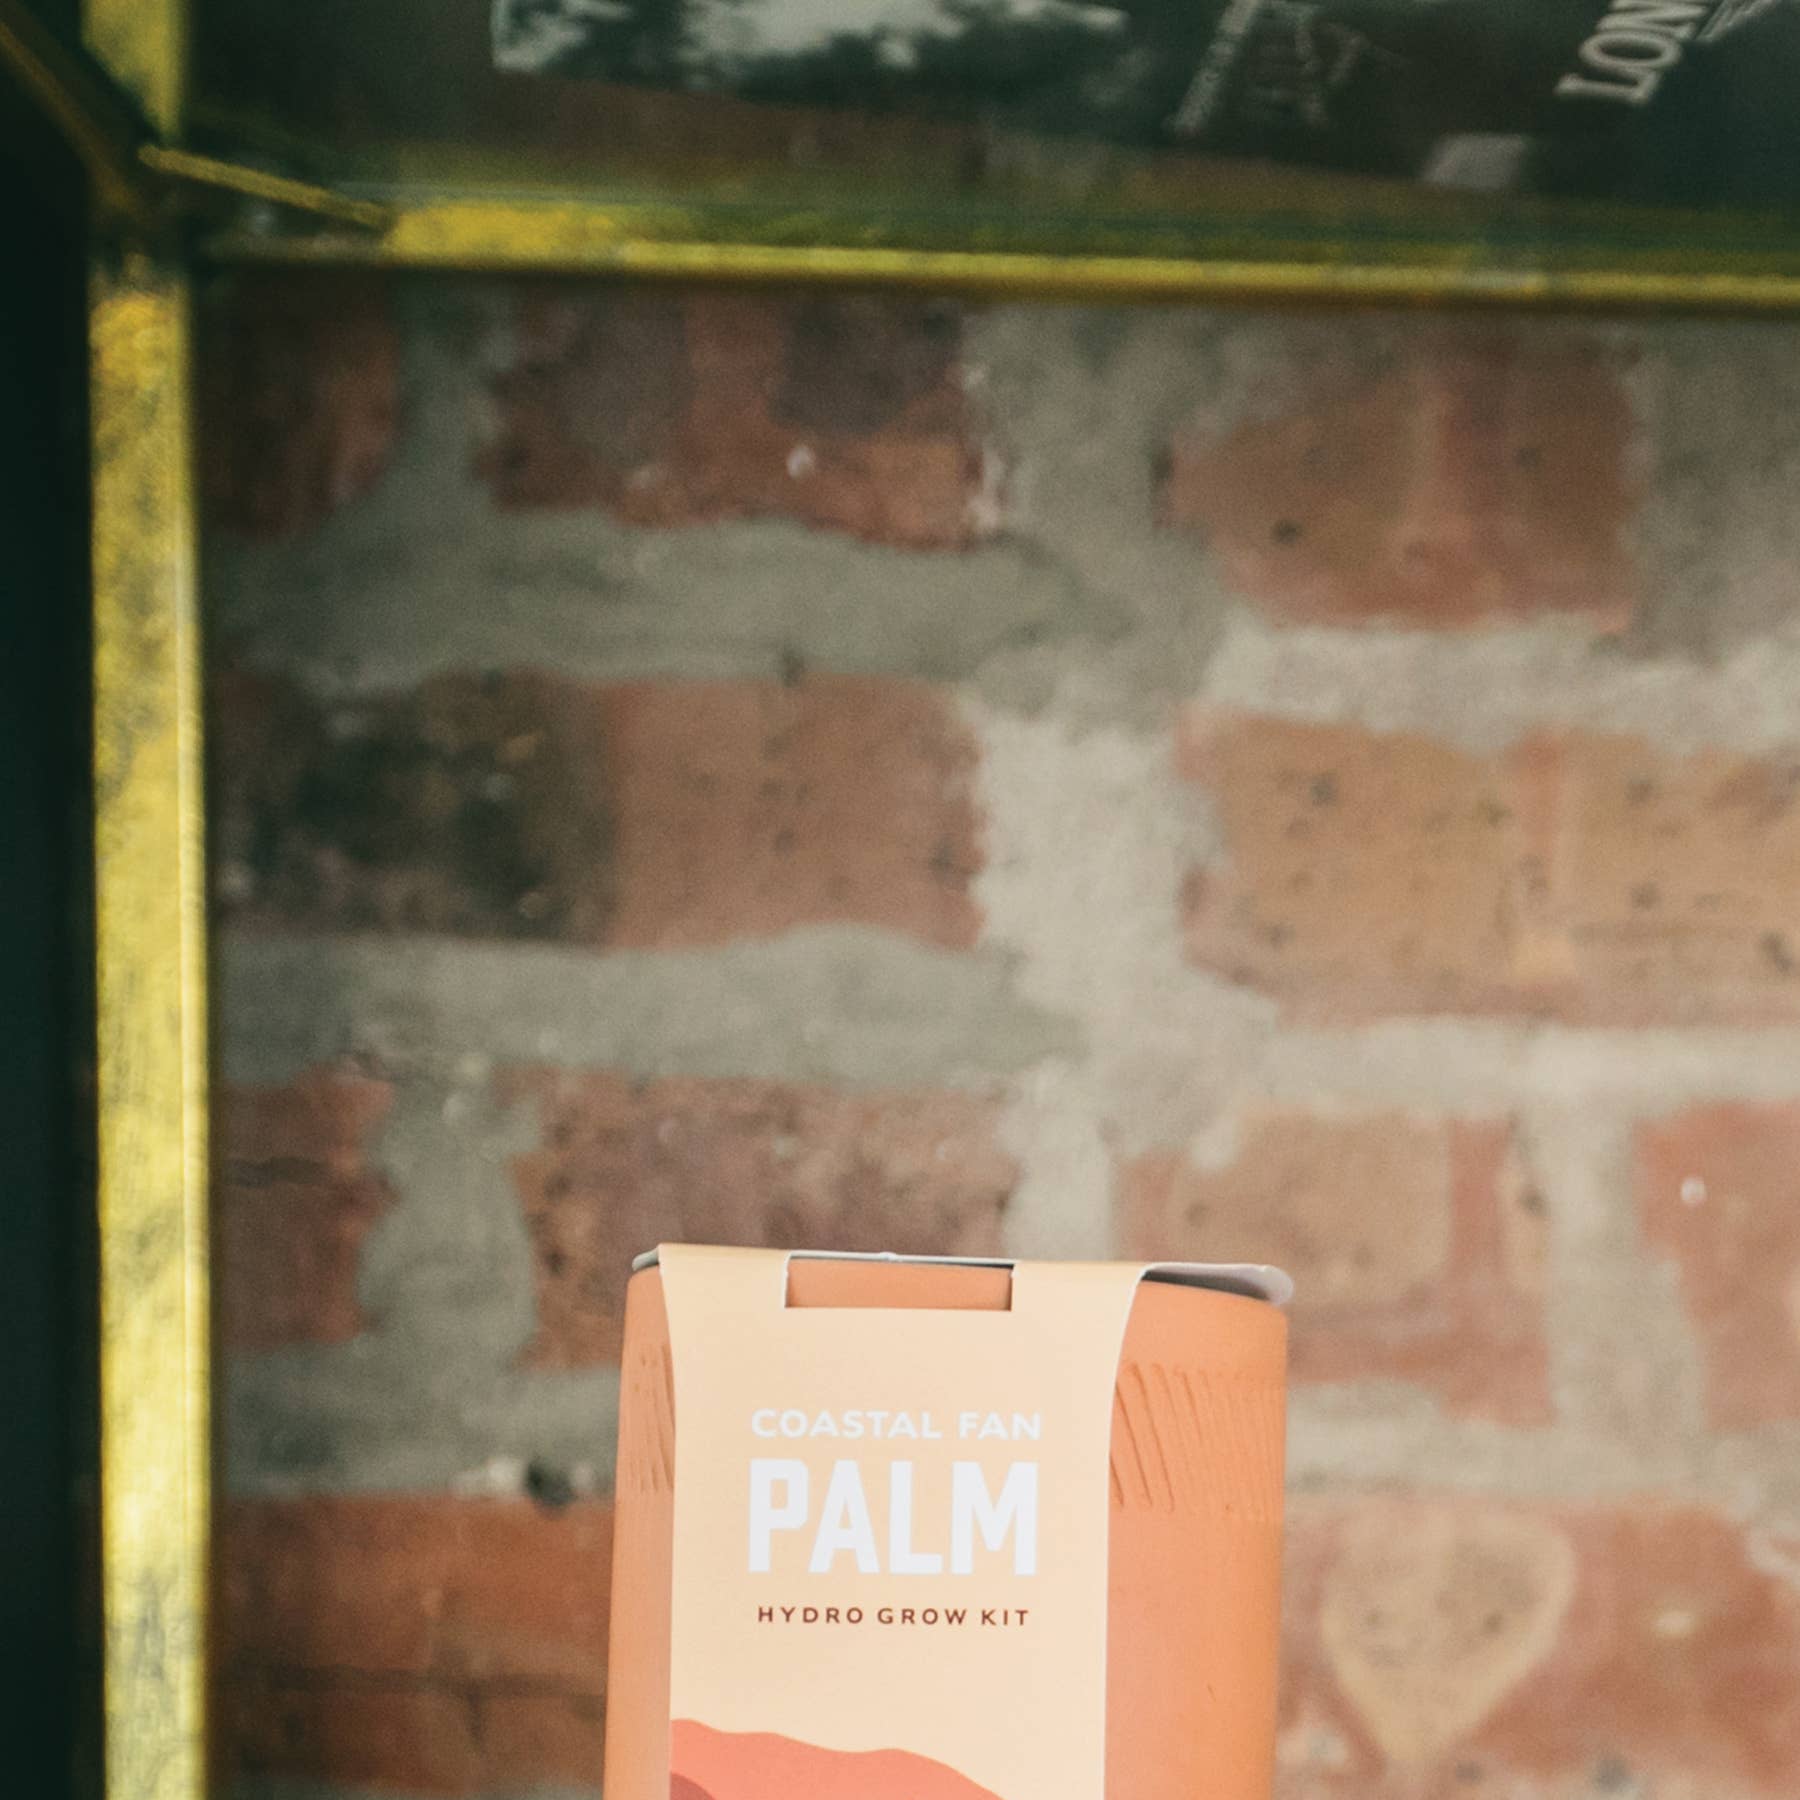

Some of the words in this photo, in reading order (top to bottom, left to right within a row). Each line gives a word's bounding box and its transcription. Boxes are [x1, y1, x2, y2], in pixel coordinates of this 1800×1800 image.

[750, 1409, 942, 1440] COASTAL
[958, 1411, 1042, 1440] FAN
[747, 1458, 1039, 1576] PALM
[757, 1606, 864, 1625] HYDRO
[877, 1607, 968, 1626] GROW
[980, 1608, 1030, 1627] KIT
